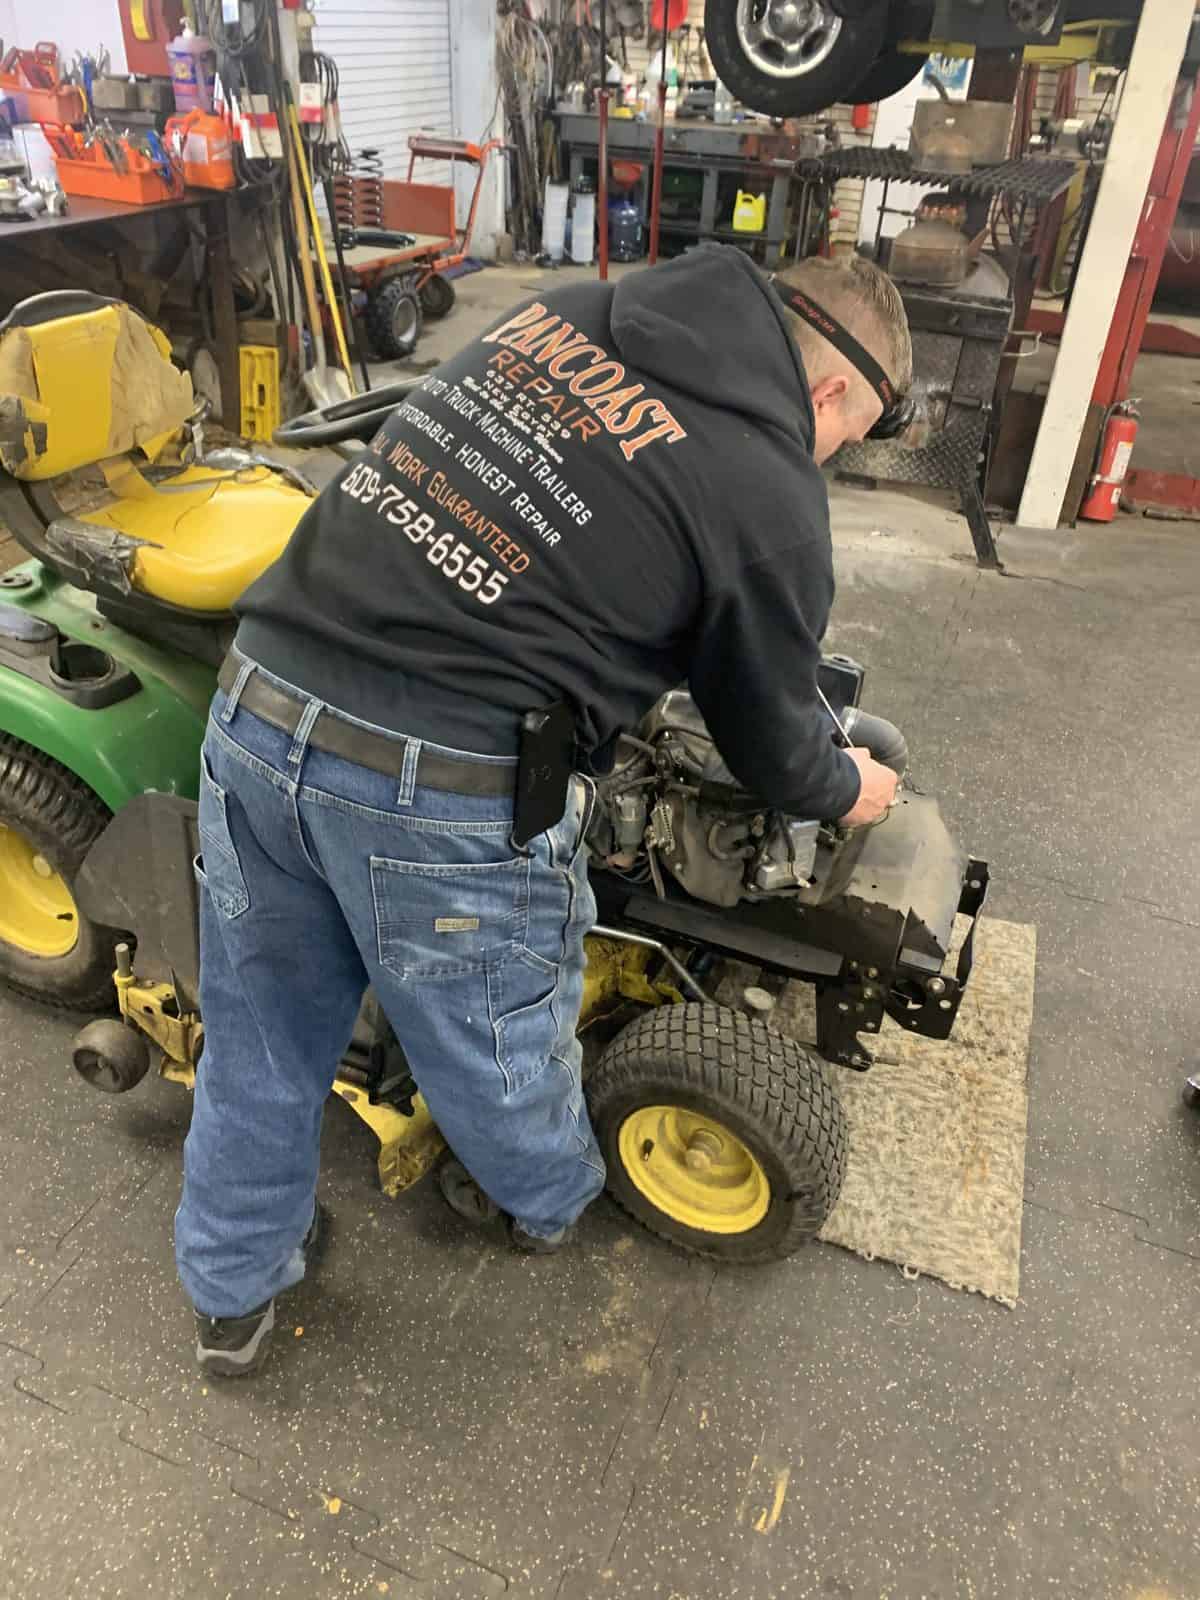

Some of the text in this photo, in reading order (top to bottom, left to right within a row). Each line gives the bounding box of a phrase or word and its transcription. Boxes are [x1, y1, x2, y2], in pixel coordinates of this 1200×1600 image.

[482, 302, 687, 461] PANCOAST
[482, 379, 554, 438] NEW EGYPT
[487, 349, 602, 443] REPAIR
[340, 462, 509, 605] 609-758-6555
[385, 440, 430, 487] WORK
[426, 471, 530, 575] GUARANTEED
[455, 443, 516, 498] HONEST
[510, 492, 562, 548] REPAIR
